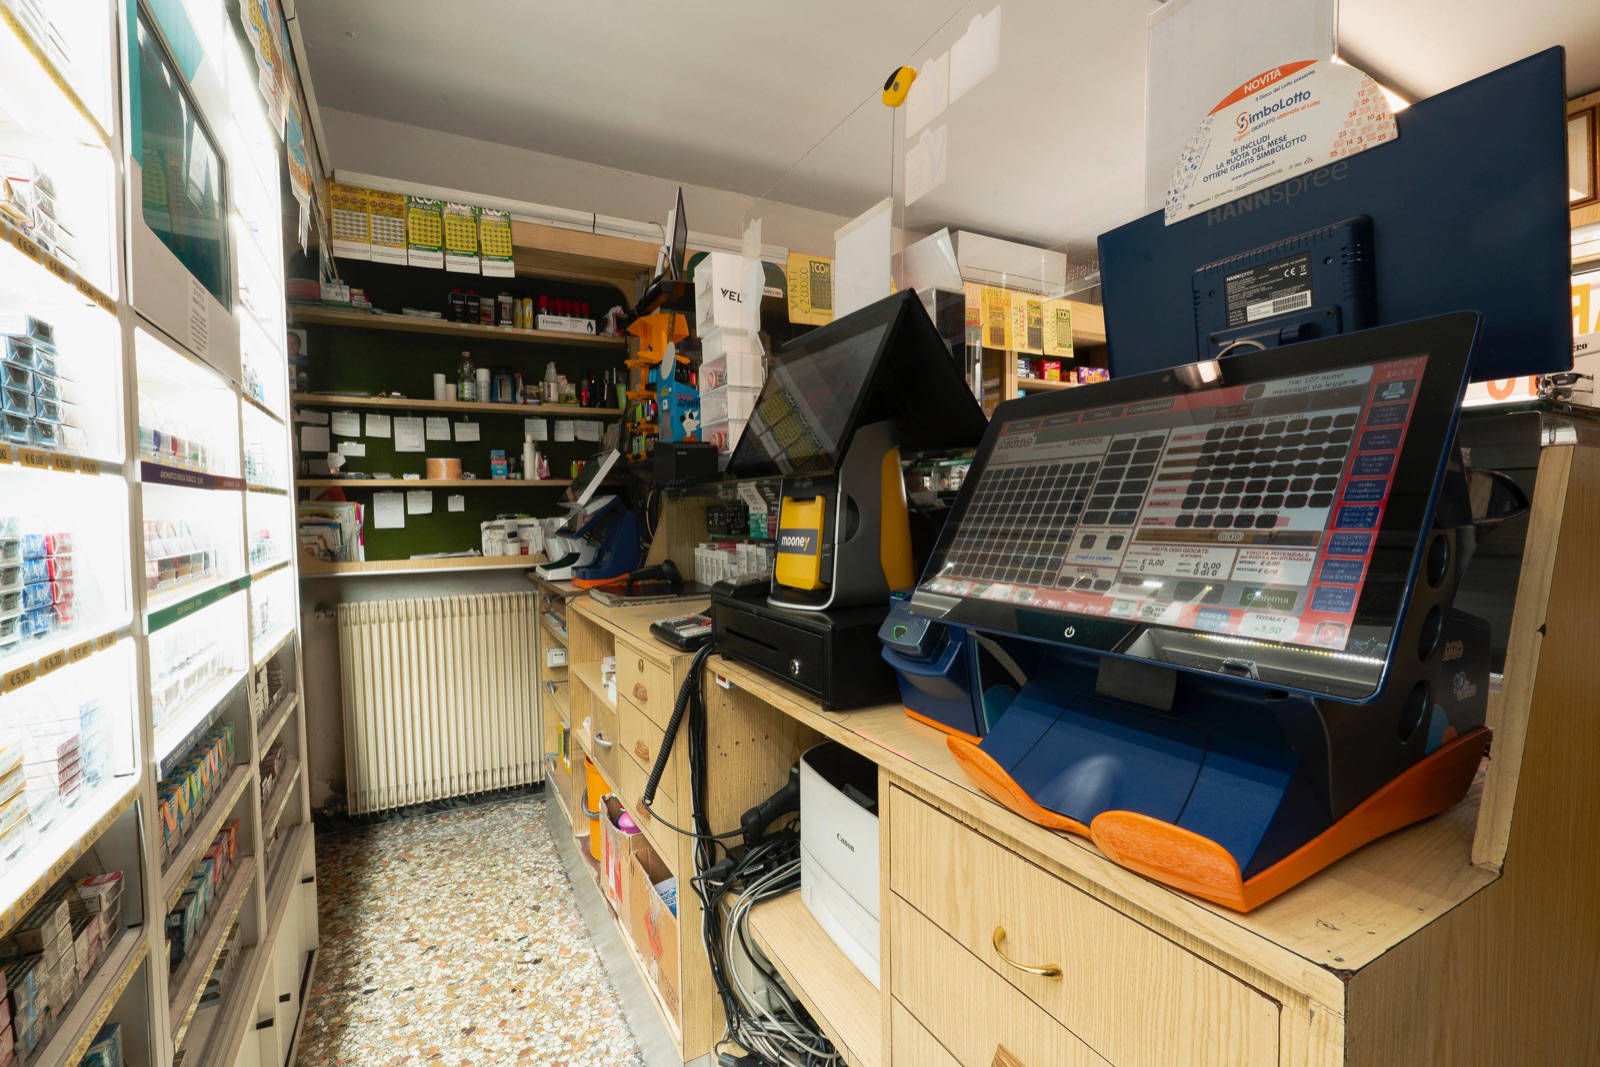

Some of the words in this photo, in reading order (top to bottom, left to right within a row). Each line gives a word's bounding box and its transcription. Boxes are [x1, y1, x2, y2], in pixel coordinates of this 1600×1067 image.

[1259, 91, 1272, 100] Gioco
[1273, 86, 1281, 94] del
[1281, 81, 1293, 90] Lotto
[1293, 69, 1316, 84] presenta
[1236, 90, 1311, 134] SimboLotto
[1376, 113, 1385, 121] 41
[1237, 131, 1250, 142] gioco
[1251, 117, 1276, 133] GRATUITO
[1276, 108, 1300, 121] abbinato
[1300, 105, 1307, 113] al
[1306, 100, 1321, 110] Lotto
[1230, 148, 1239, 157] SE
[1241, 134, 1270, 153] INCLUDI
[1357, 136, 1363, 144] 3
[1378, 133, 1386, 141] 25
[1203, 167, 1229, 183] OTTIENI
[1230, 157, 1255, 172] GRATIS
[1256, 134, 1307, 161] SIMBOLOTTO
[1216, 162, 1225, 170] LA
[1226, 152, 1250, 167] RUOTA
[1252, 145, 1264, 155] DEL
[1267, 134, 1288, 149] MESE
[23, 241, 37, 258] 6,00
[54, 265, 66, 278] 6,00
[721, 287, 743, 303] VEL
[789, 271, 799, 310] VINTI
[1304, 375, 1319, 384] 127
[1321, 372, 1345, 381] nuovi
[1387, 368, 1414, 378] 10:53
[1272, 385, 1311, 396] messaggi
[1312, 383, 1323, 391] da
[1324, 378, 1358, 390] leggere
[1129, 402, 1172, 413] Configurazioni
[25, 453, 31, 464] €
[30, 454, 44, 466] 6,00
[56, 457, 60, 468] €
[60, 458, 72, 470] 5,50
[781, 535, 810, 552] mooney
[1140, 564, 1145, 572] 0
[1148, 559, 1165, 567] 0,00
[1203, 562, 1222, 571] 0,00
[1193, 568, 1199, 576] 0
[1200, 568, 1209, 576] di
[1211, 569, 1218, 577] 0
[1200, 611, 1227, 620] AZZERA
[1255, 614, 1280, 622] TOTALE
[1254, 624, 1282, 635] +3,50
[73, 649, 78, 659] €
[78, 645, 88, 658] 5,40
[44, 660, 50, 671] €
[50, 654, 62, 669] 5,20
[10, 674, 16, 686] €
[16, 668, 31, 685] 5,70
[836, 832, 855, 853] Canon
[53, 867, 58, 877] €
[58, 854, 71, 872] 5,30
[20, 898, 26, 910] €
[26, 885, 40, 903] 5,30
[61, 951, 74, 967] LUCKY
